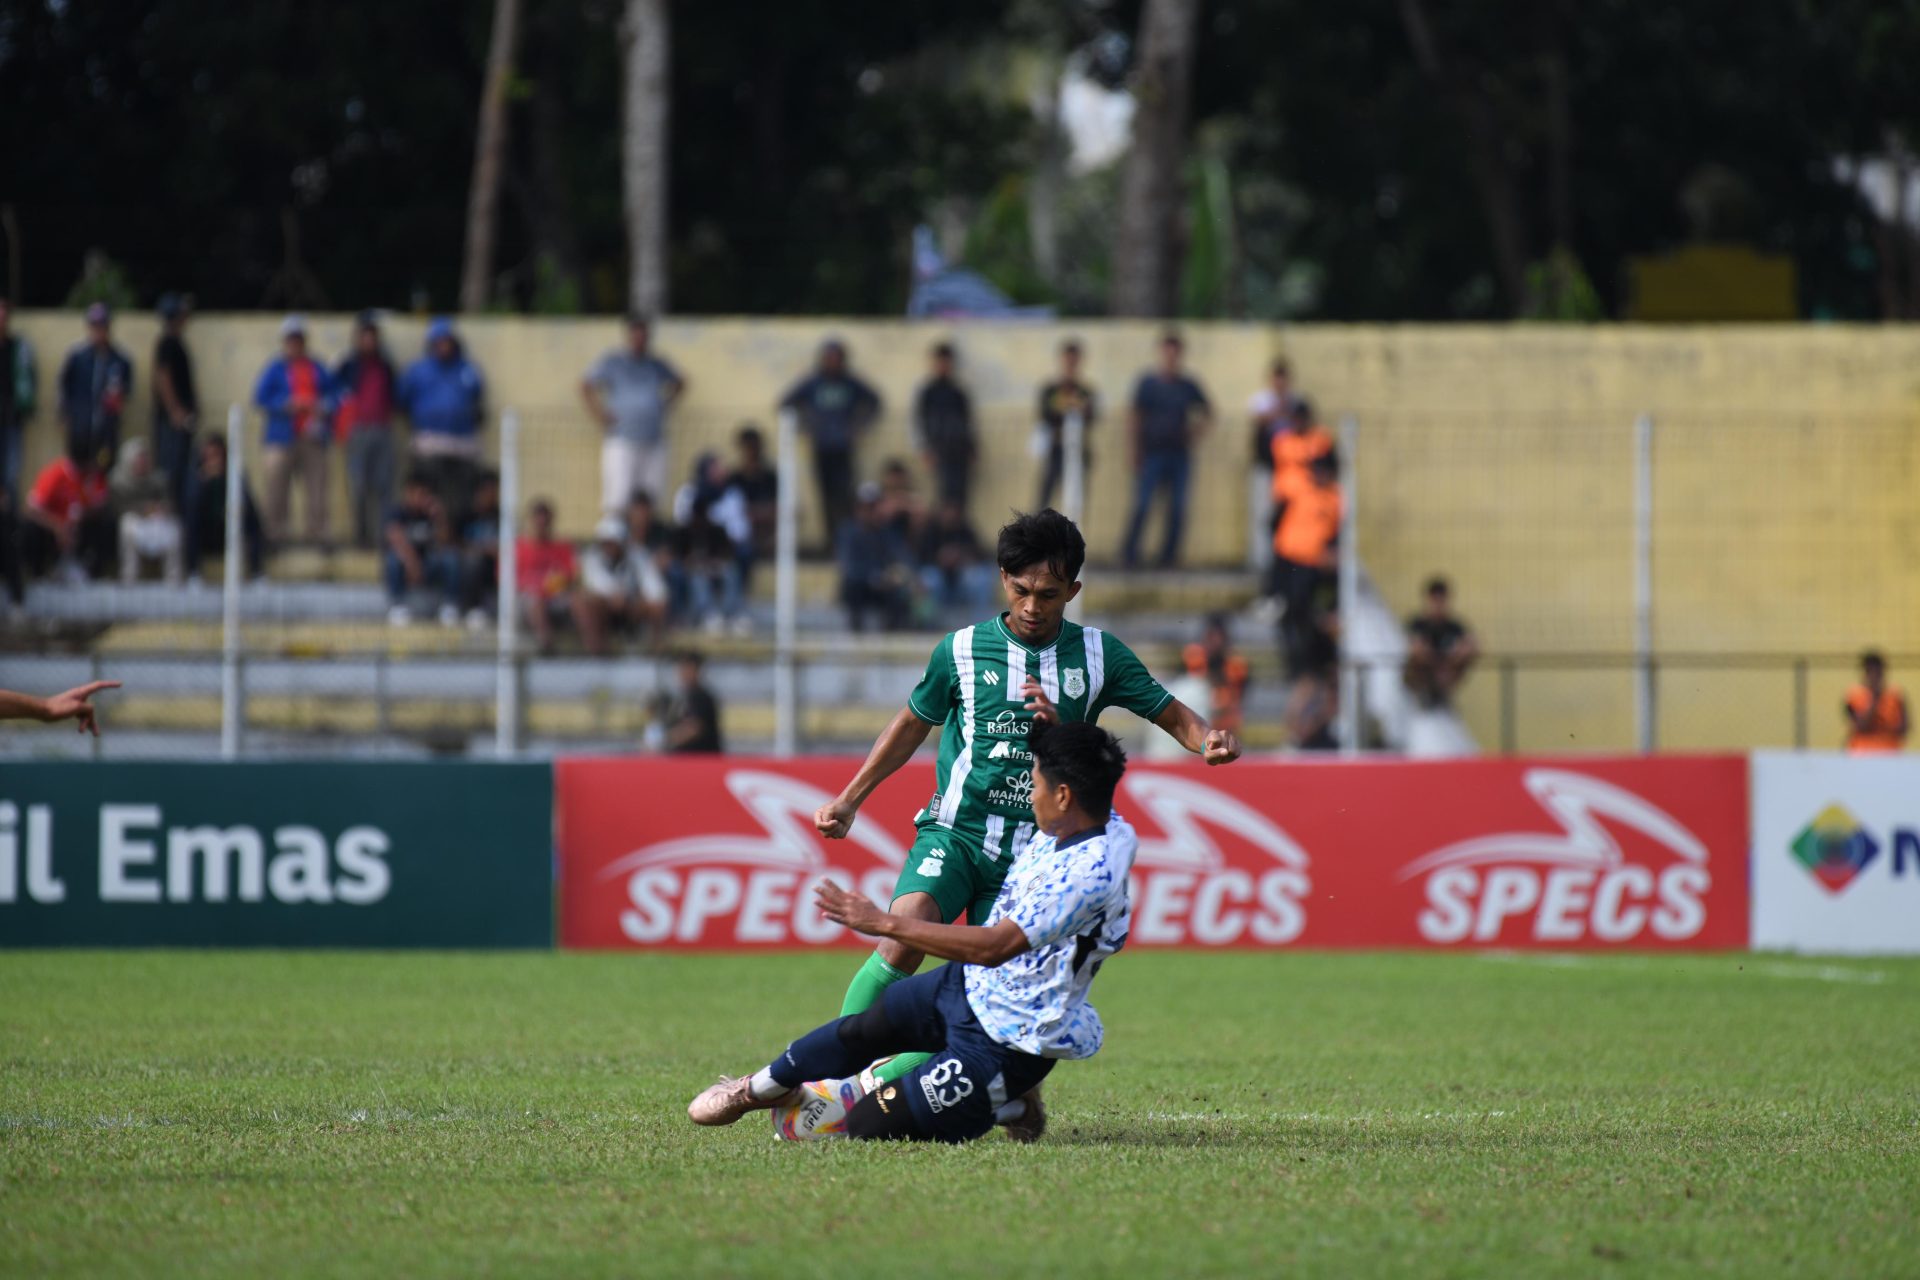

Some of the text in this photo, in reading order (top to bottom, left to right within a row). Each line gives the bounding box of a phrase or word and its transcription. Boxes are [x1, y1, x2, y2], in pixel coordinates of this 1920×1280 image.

[987, 721, 1032, 734] BankS
[99, 804, 391, 904] Emas
[1418, 864, 1710, 942] SPECS
[929, 1058, 974, 1107] 63
